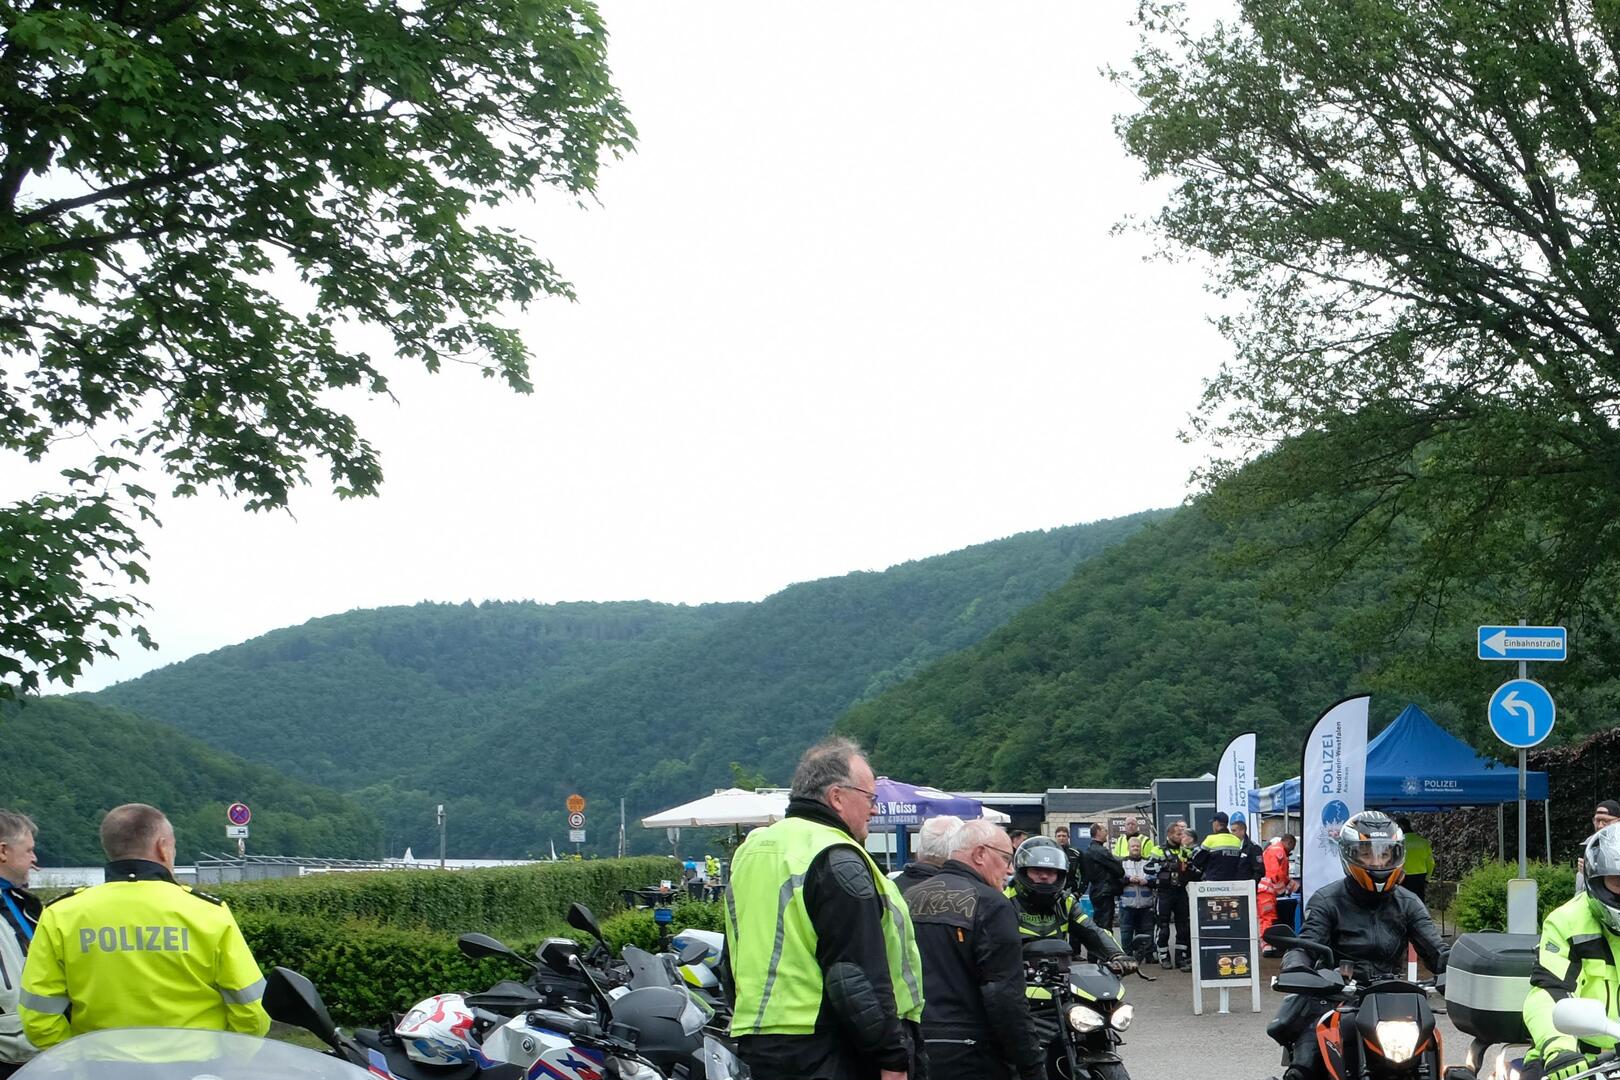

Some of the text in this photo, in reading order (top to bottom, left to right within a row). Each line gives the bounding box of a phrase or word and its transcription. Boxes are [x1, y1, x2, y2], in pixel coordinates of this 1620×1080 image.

[1503, 638, 1562, 649] Einbahnstraße
[1322, 733, 1334, 795] POLIZEI
[1424, 780, 1458, 788] POLIZEI
[888, 801, 917, 815] Weisse
[79, 926, 190, 953] POLIZEI
